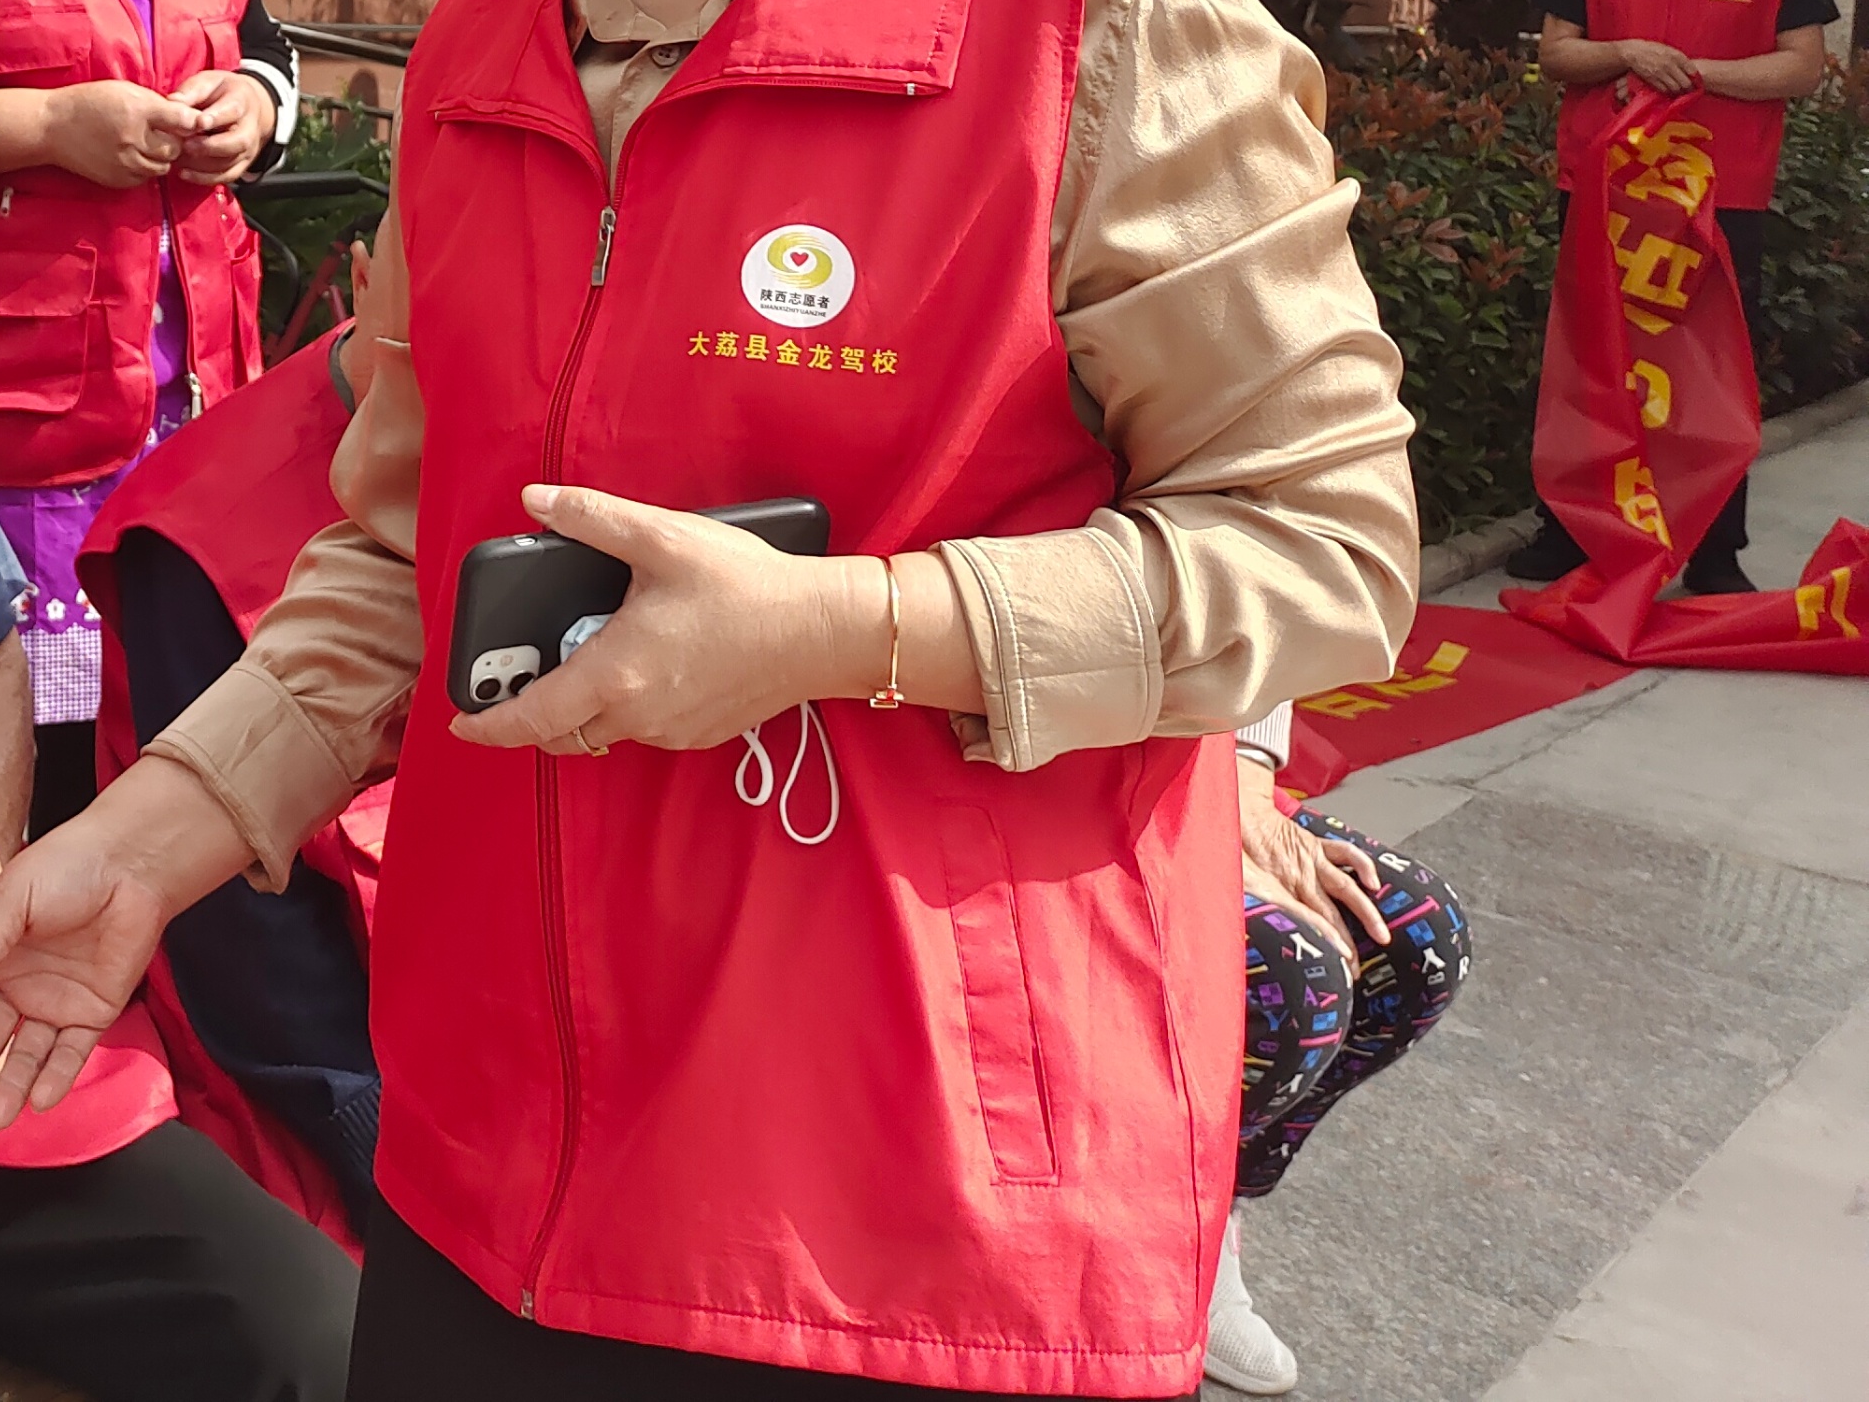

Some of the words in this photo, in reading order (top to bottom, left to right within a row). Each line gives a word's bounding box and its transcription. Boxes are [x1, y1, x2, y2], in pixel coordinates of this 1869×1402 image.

[759, 288, 830, 309] 陕西志愿者
[687, 330, 899, 375] 大荔县金龙驾校
